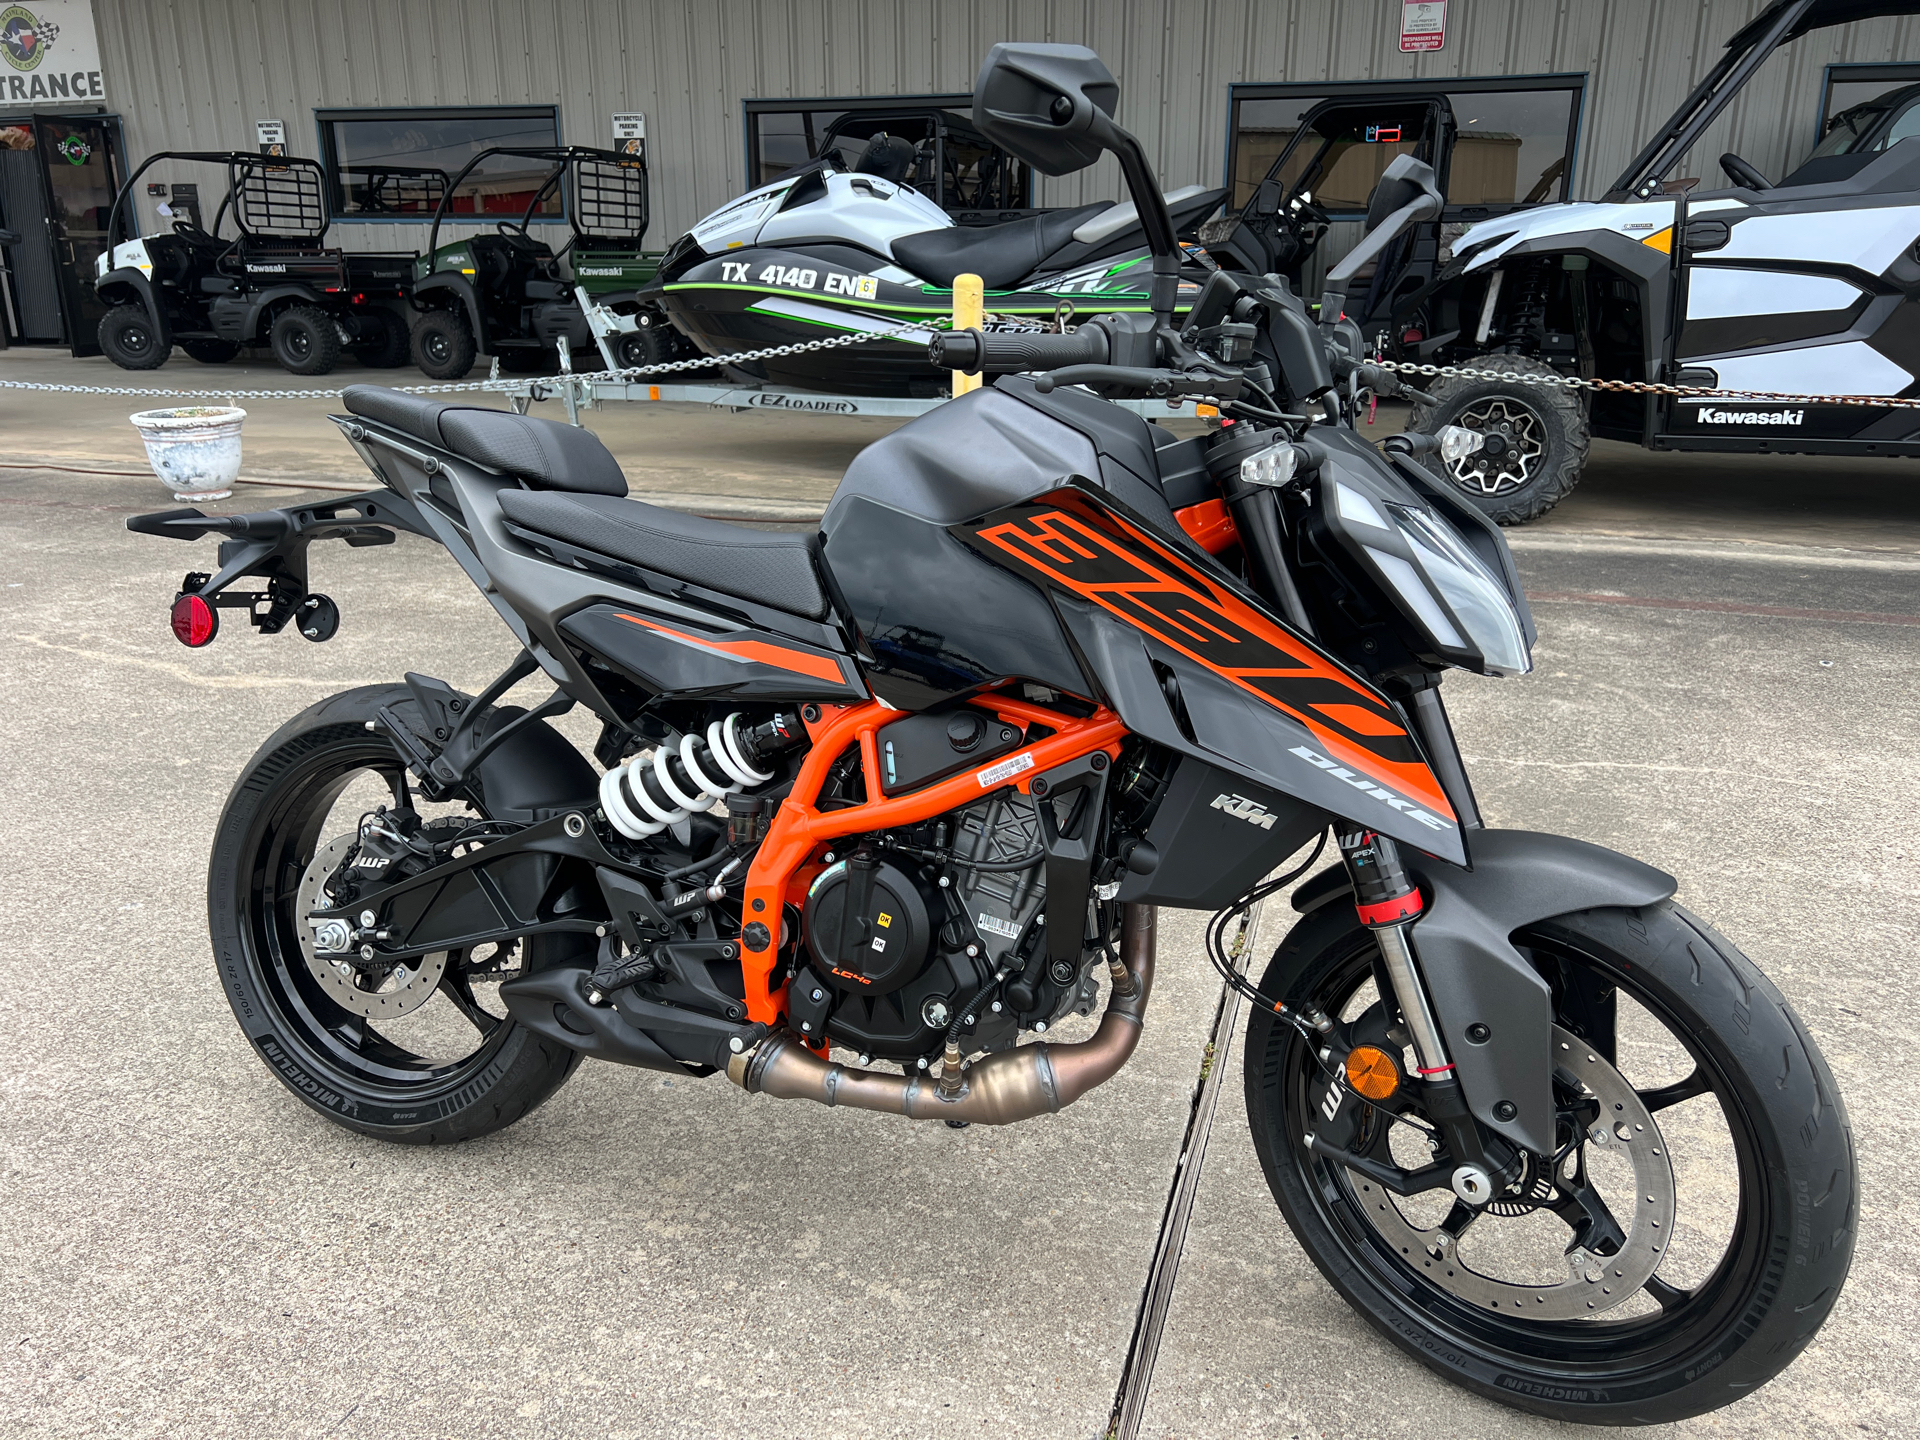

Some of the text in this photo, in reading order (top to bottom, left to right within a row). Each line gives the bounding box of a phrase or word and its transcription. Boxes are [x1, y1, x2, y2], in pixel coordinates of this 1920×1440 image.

[2, 9, 33, 23] MAINLAND
[5, 49, 42, 68] CYCLE CENTER
[246, 264, 286, 273] Kawasaki
[579, 267, 622, 276] Kawasaki
[722, 262, 857, 296] TX 4140 EN
[862, 281, 870, 293] 6
[1697, 408, 1804, 425] Kawasaki
[774, 713, 790, 738] WP
[1287, 745, 1453, 831] DUKE
[1209, 793, 1278, 830] KTM
[1351, 848, 1375, 858] APEX
[359, 857, 390, 868] WP
[674, 892, 696, 906] WP
[880, 915, 890, 924] OK
[874, 940, 884, 949] OK
[223, 951, 232, 961] 17
[227, 965, 238, 979] ZR
[233, 983, 254, 1019] 150/60
[263, 1042, 340, 1107] MICHELIN
[1321, 1062, 1347, 1122] WP
[1794, 1180, 1811, 1267] POWER 6
[1389, 1317, 1467, 1368] 110/70 ZR 17
[1696, 1351, 1723, 1375] FRONT
[1503, 1377, 1588, 1401] MICHELIN
